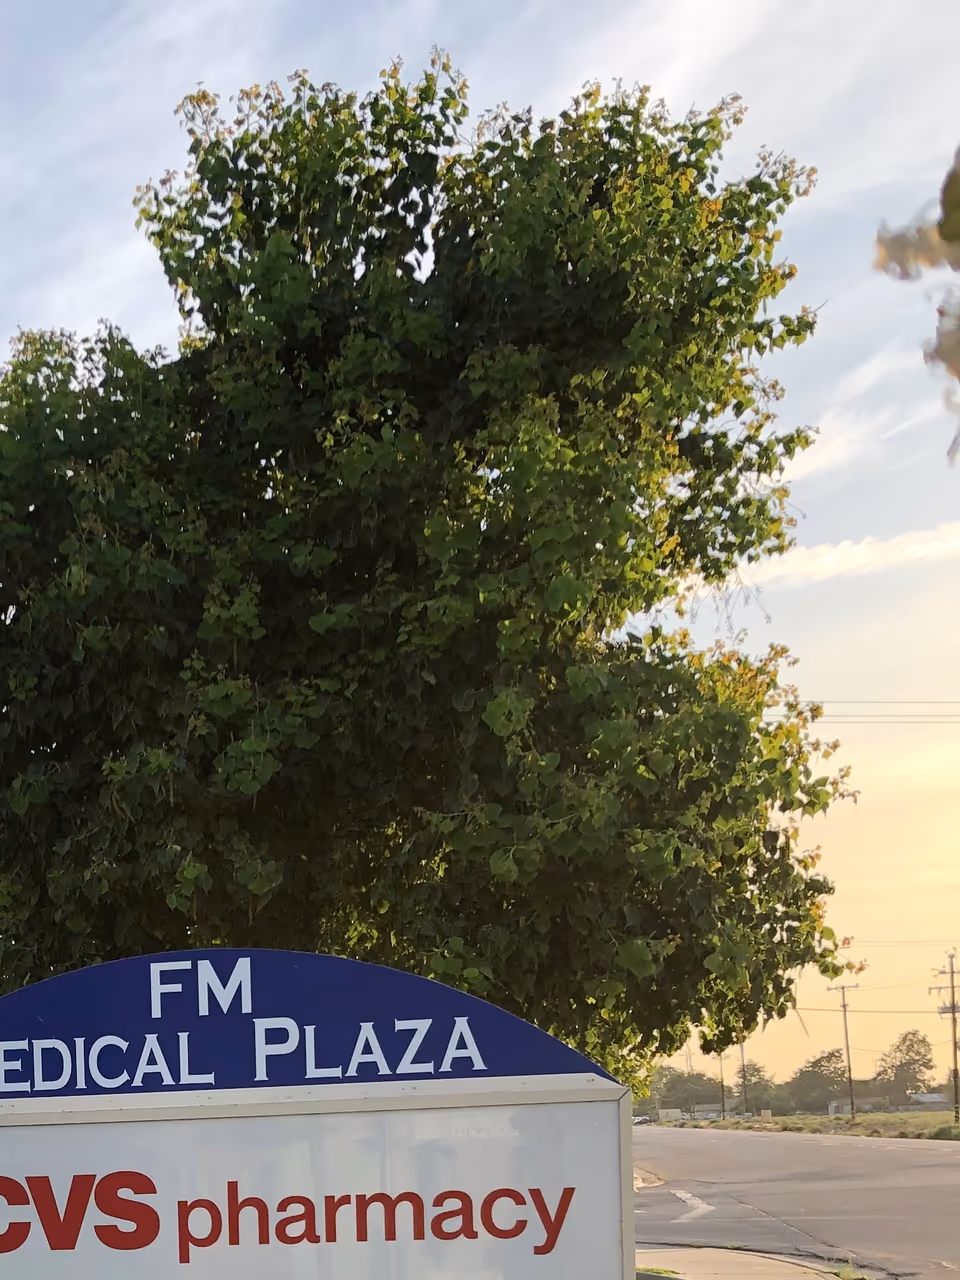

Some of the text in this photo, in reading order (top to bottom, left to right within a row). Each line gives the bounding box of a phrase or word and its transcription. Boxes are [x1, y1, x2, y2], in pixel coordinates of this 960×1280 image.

[150, 957, 253, 1019] FM
[252, 1016, 488, 1082] PLAZA
[177, 1181, 577, 1263] pharmacy
